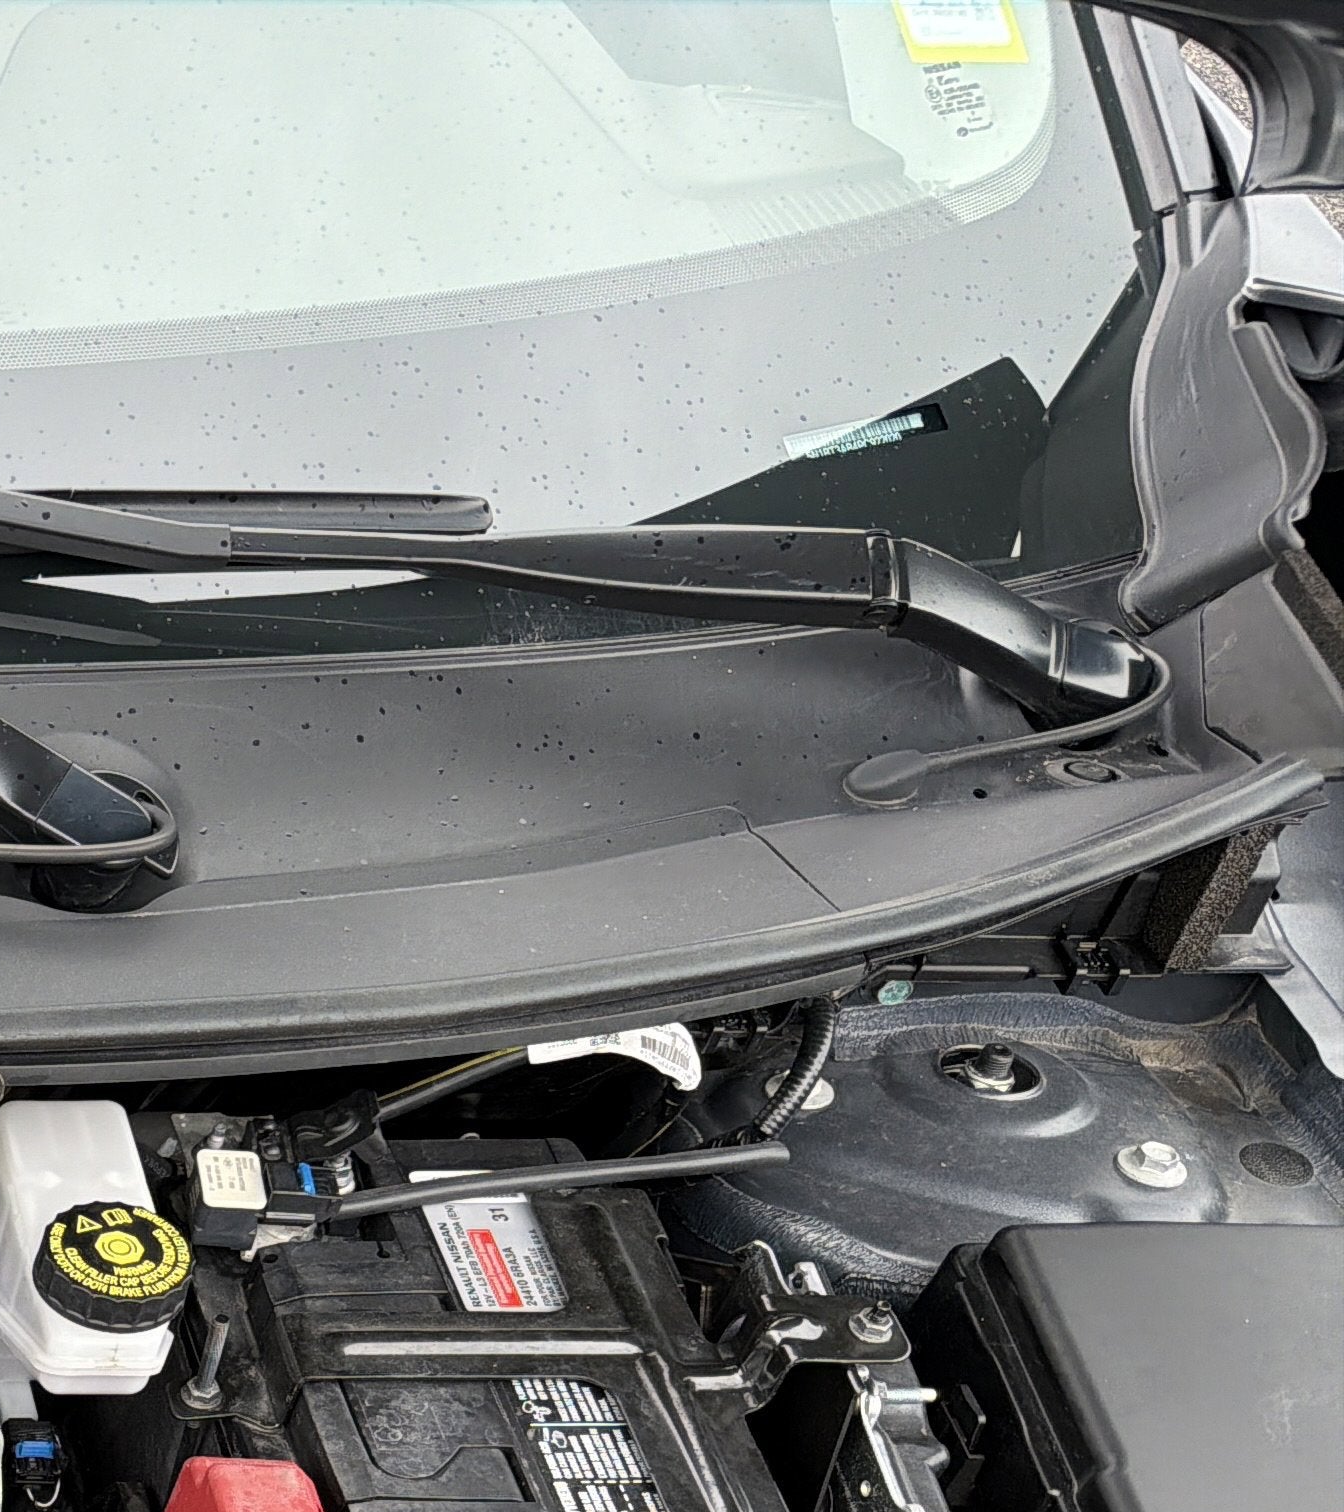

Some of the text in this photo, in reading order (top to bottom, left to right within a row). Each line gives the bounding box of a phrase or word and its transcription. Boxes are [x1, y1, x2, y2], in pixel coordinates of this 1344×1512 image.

[487, 1208, 509, 1221] 31
[65, 1248, 88, 1274] CLEAN
[86, 1268, 118, 1286] FILLER
[120, 1277, 140, 1286] CAP
[140, 1262, 173, 1284] BEFORE
[113, 1260, 156, 1276] WARNING
[438, 1222, 482, 1306] RENAULT NISSAN
[70, 1270, 85, 1282] OR
[109, 1286, 144, 1297] BRAKE
[143, 1280, 170, 1296] FLUID
[515, 1280, 537, 1306] 24410
